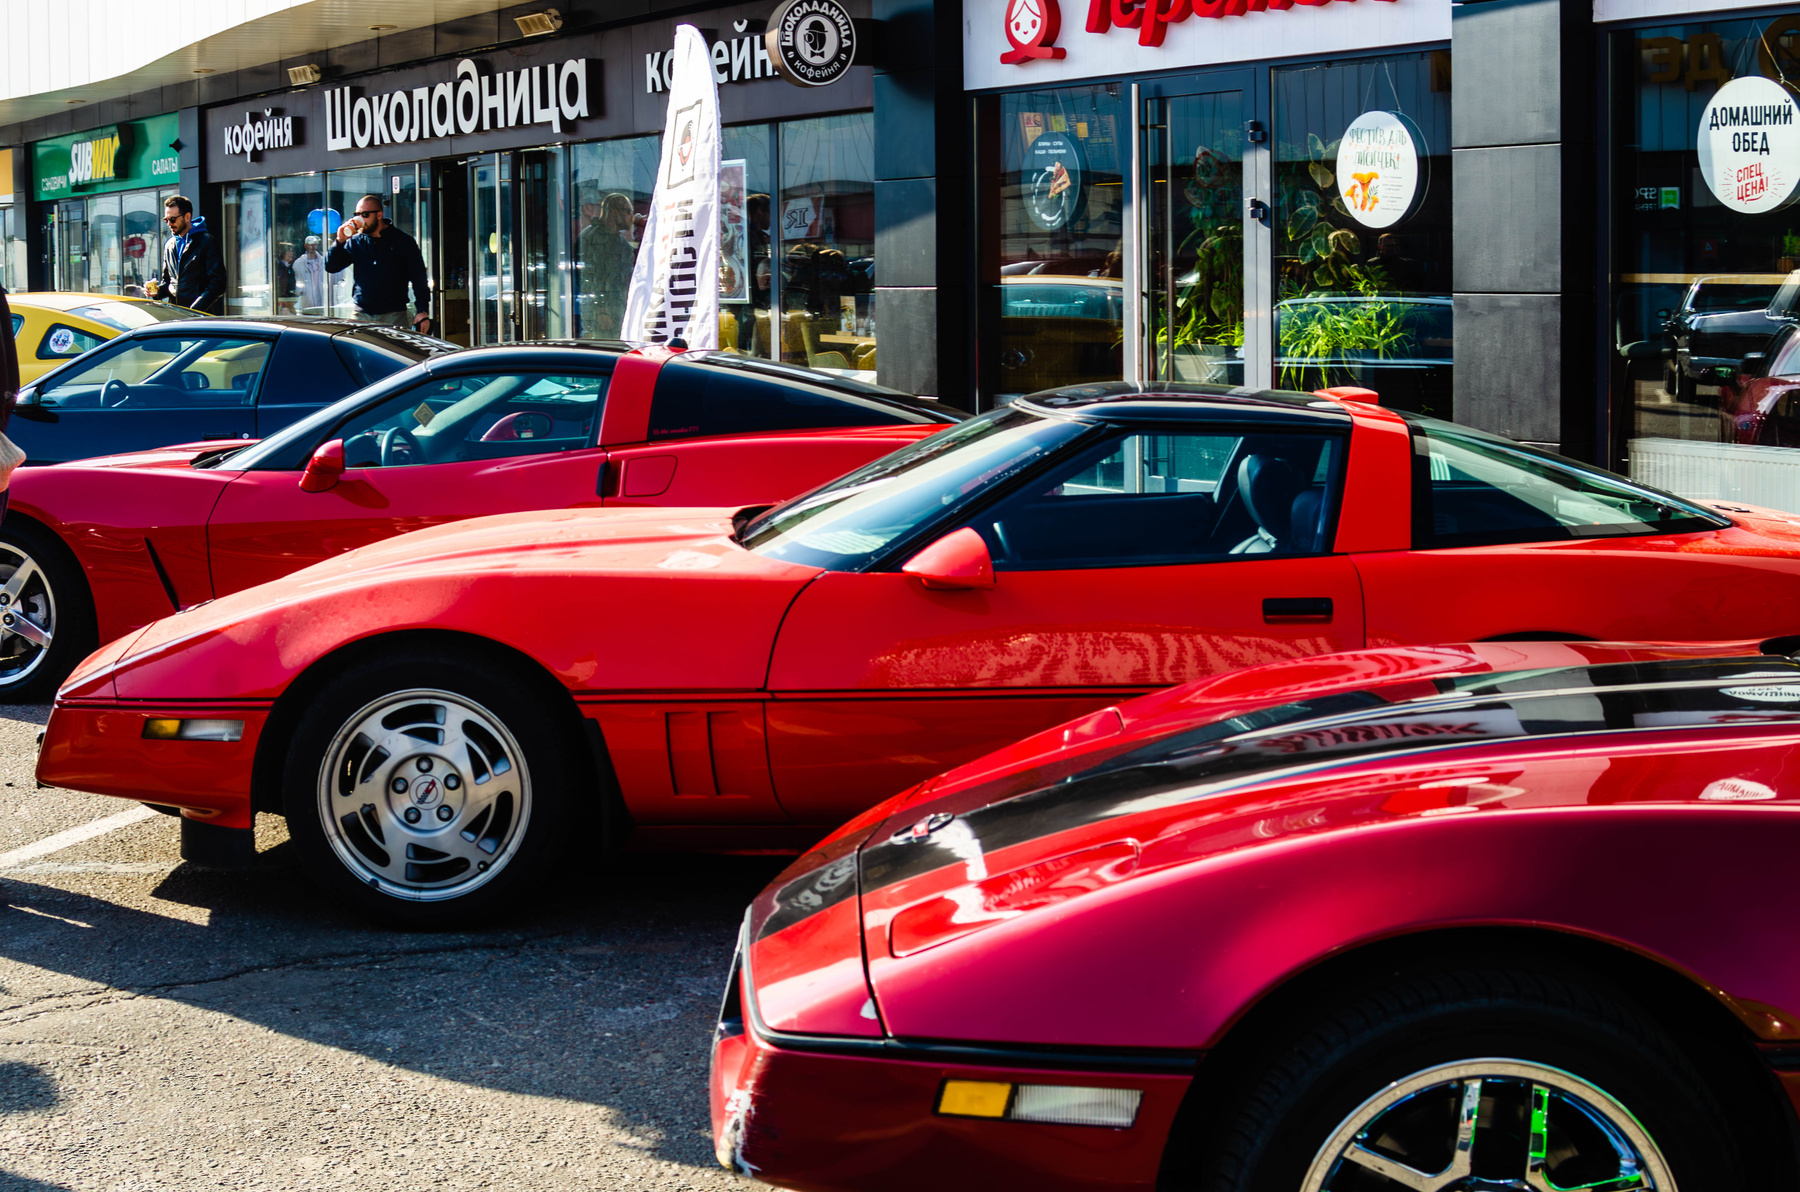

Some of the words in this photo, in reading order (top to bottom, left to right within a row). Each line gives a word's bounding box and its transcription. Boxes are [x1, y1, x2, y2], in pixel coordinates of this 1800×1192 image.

[781, 0, 852, 48] ШОКОЛАДНИЦА
[794, 60, 840, 79] кофейня
[324, 58, 589, 152] Шоколадница
[1709, 98, 1793, 131] ДОМАШНИЙ
[224, 107, 293, 163] кофейня
[1349, 126, 1407, 147] ФЕСТИВАЛЬ
[1732, 132, 1770, 156] ОБЕД
[68, 131, 121, 186] SUBWAY
[152, 156, 179, 176] САЛАТЫ
[41, 175, 67, 192] СЭНДВИЧИ
[1737, 176, 1769, 202] ЦЕНА!
